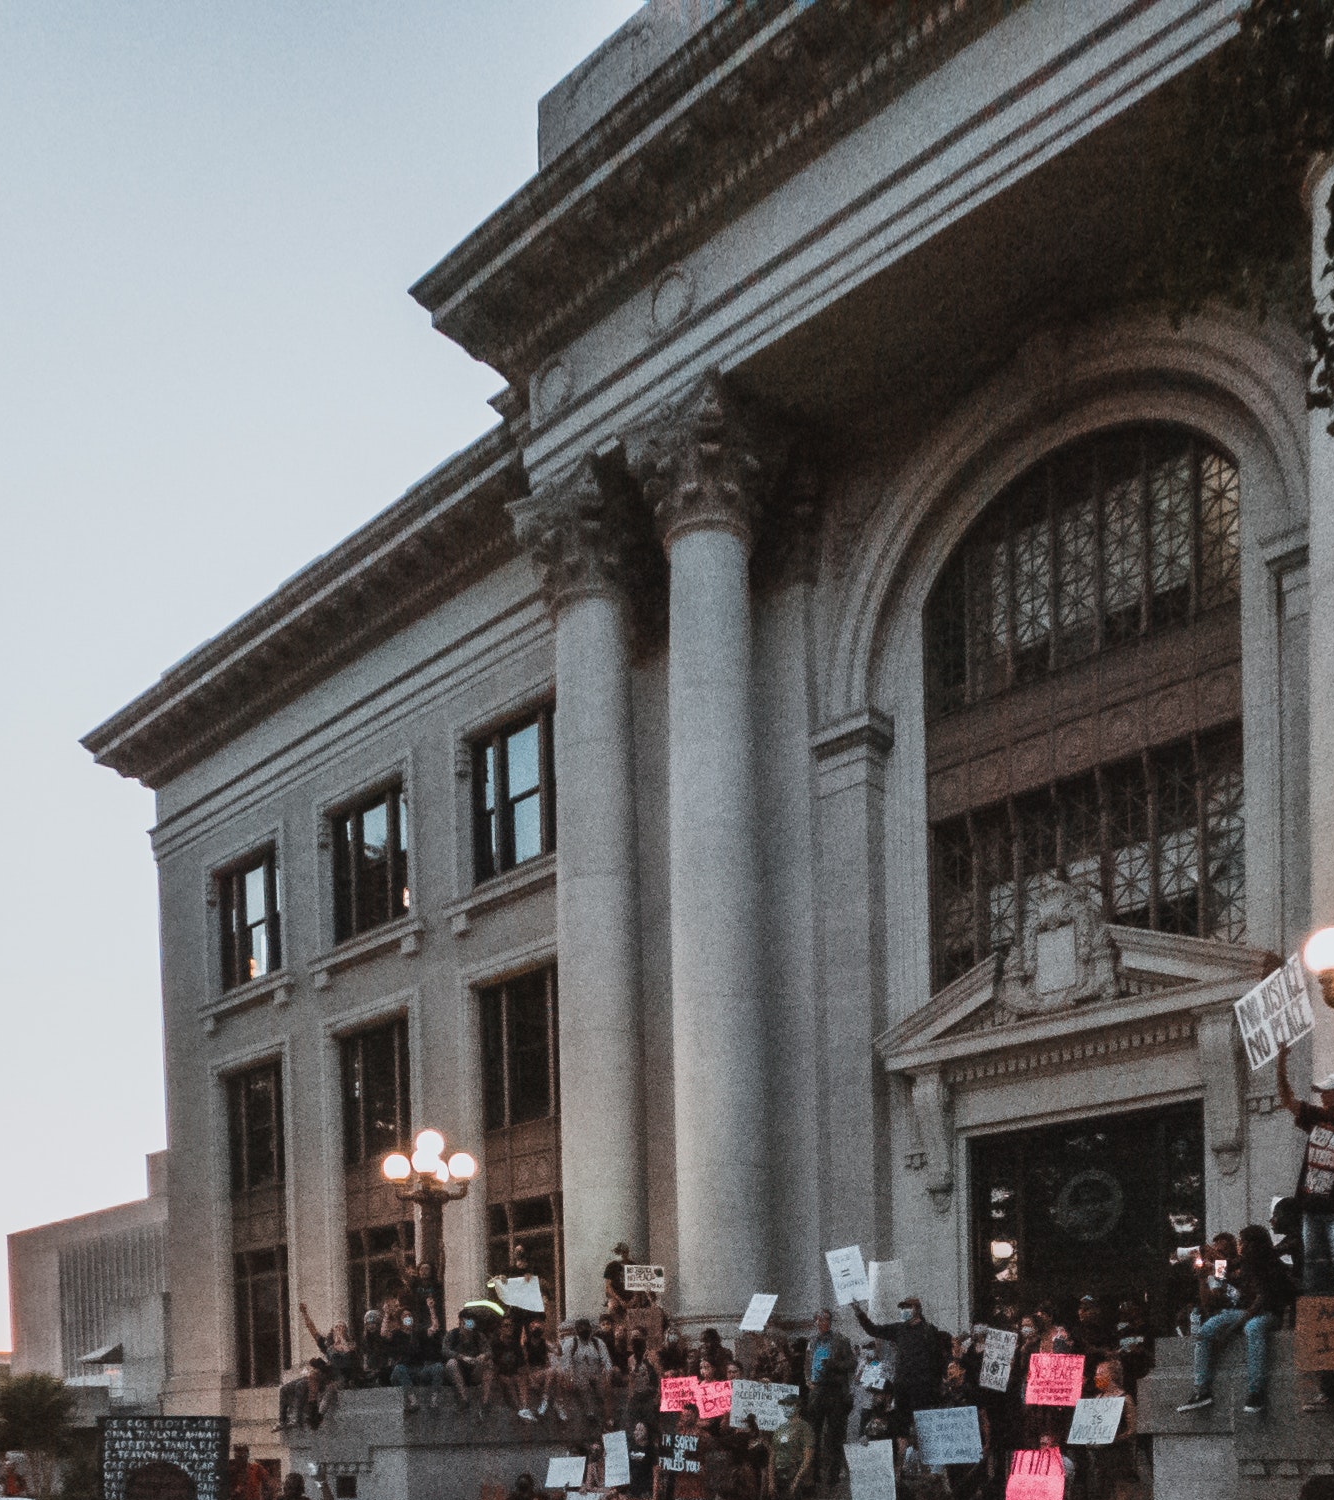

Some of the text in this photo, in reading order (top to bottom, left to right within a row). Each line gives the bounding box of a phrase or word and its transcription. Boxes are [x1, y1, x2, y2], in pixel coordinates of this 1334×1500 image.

[1238, 993, 1262, 1035] NO
[1246, 1026, 1271, 1067] NO
[673, 1434, 699, 1452] SORRY
[658, 1456, 685, 1472] FAILED
